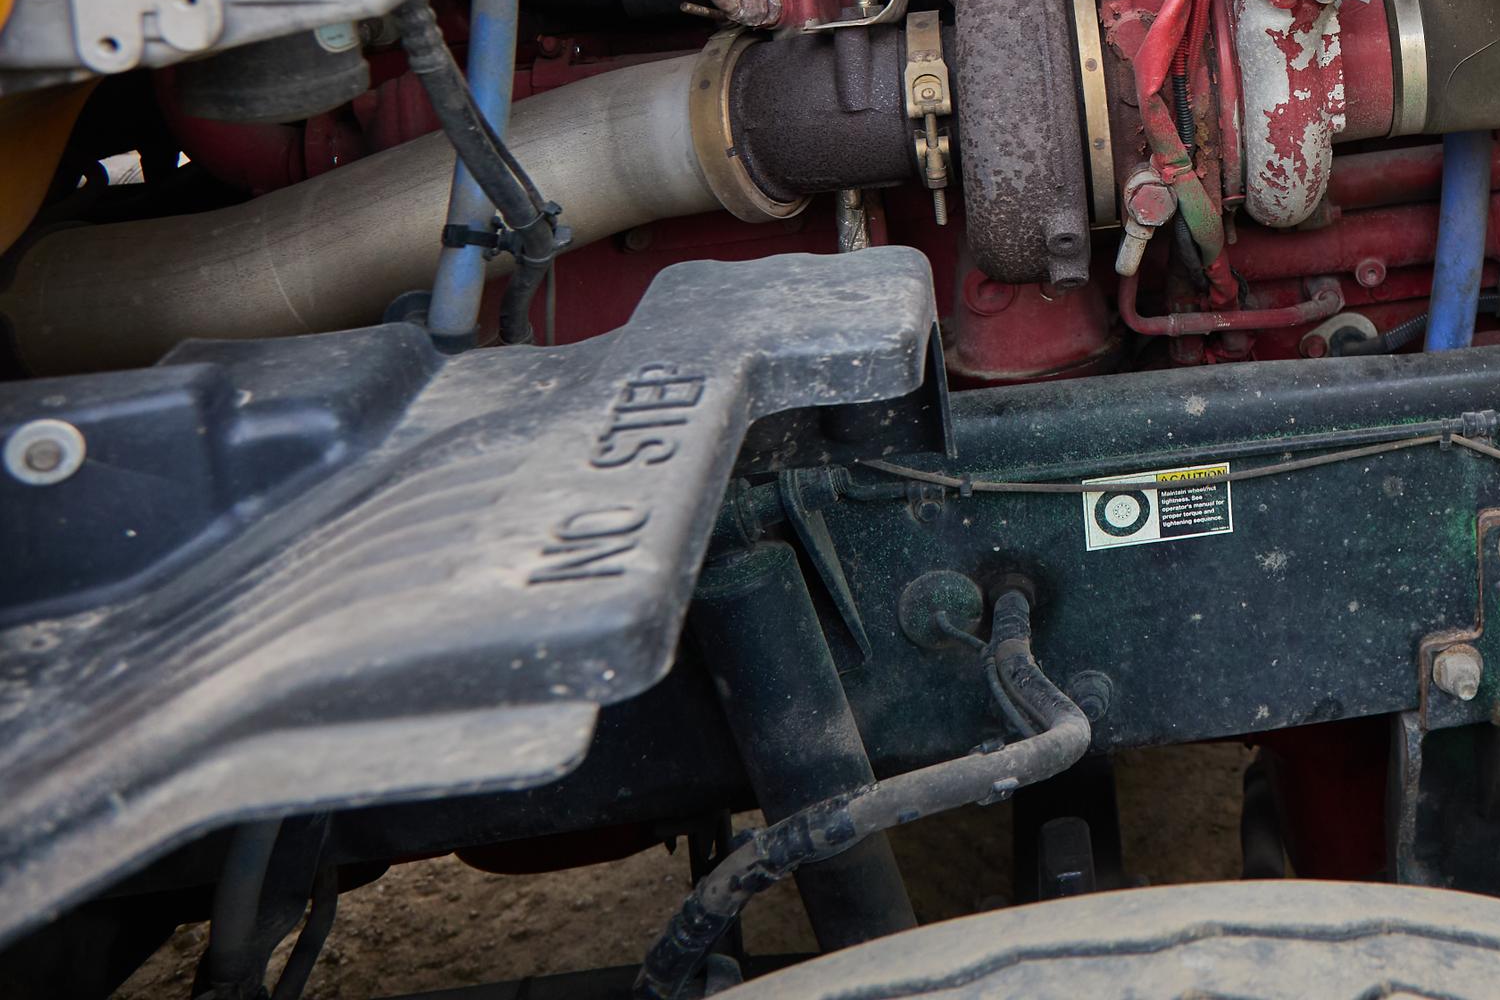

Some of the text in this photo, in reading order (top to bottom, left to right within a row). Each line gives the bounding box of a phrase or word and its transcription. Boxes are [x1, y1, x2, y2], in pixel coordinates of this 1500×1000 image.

[527, 360, 706, 586] NO STEP
[1161, 489, 1186, 497] Maintain
[1161, 497, 1190, 505] tightness.
[1162, 504, 1192, 512] operator's
[1193, 500, 1215, 508] manual
[1162, 512, 1182, 520] proper
[1183, 510, 1202, 518] torque
[1162, 515, 1223, 527] tightening sequence.
